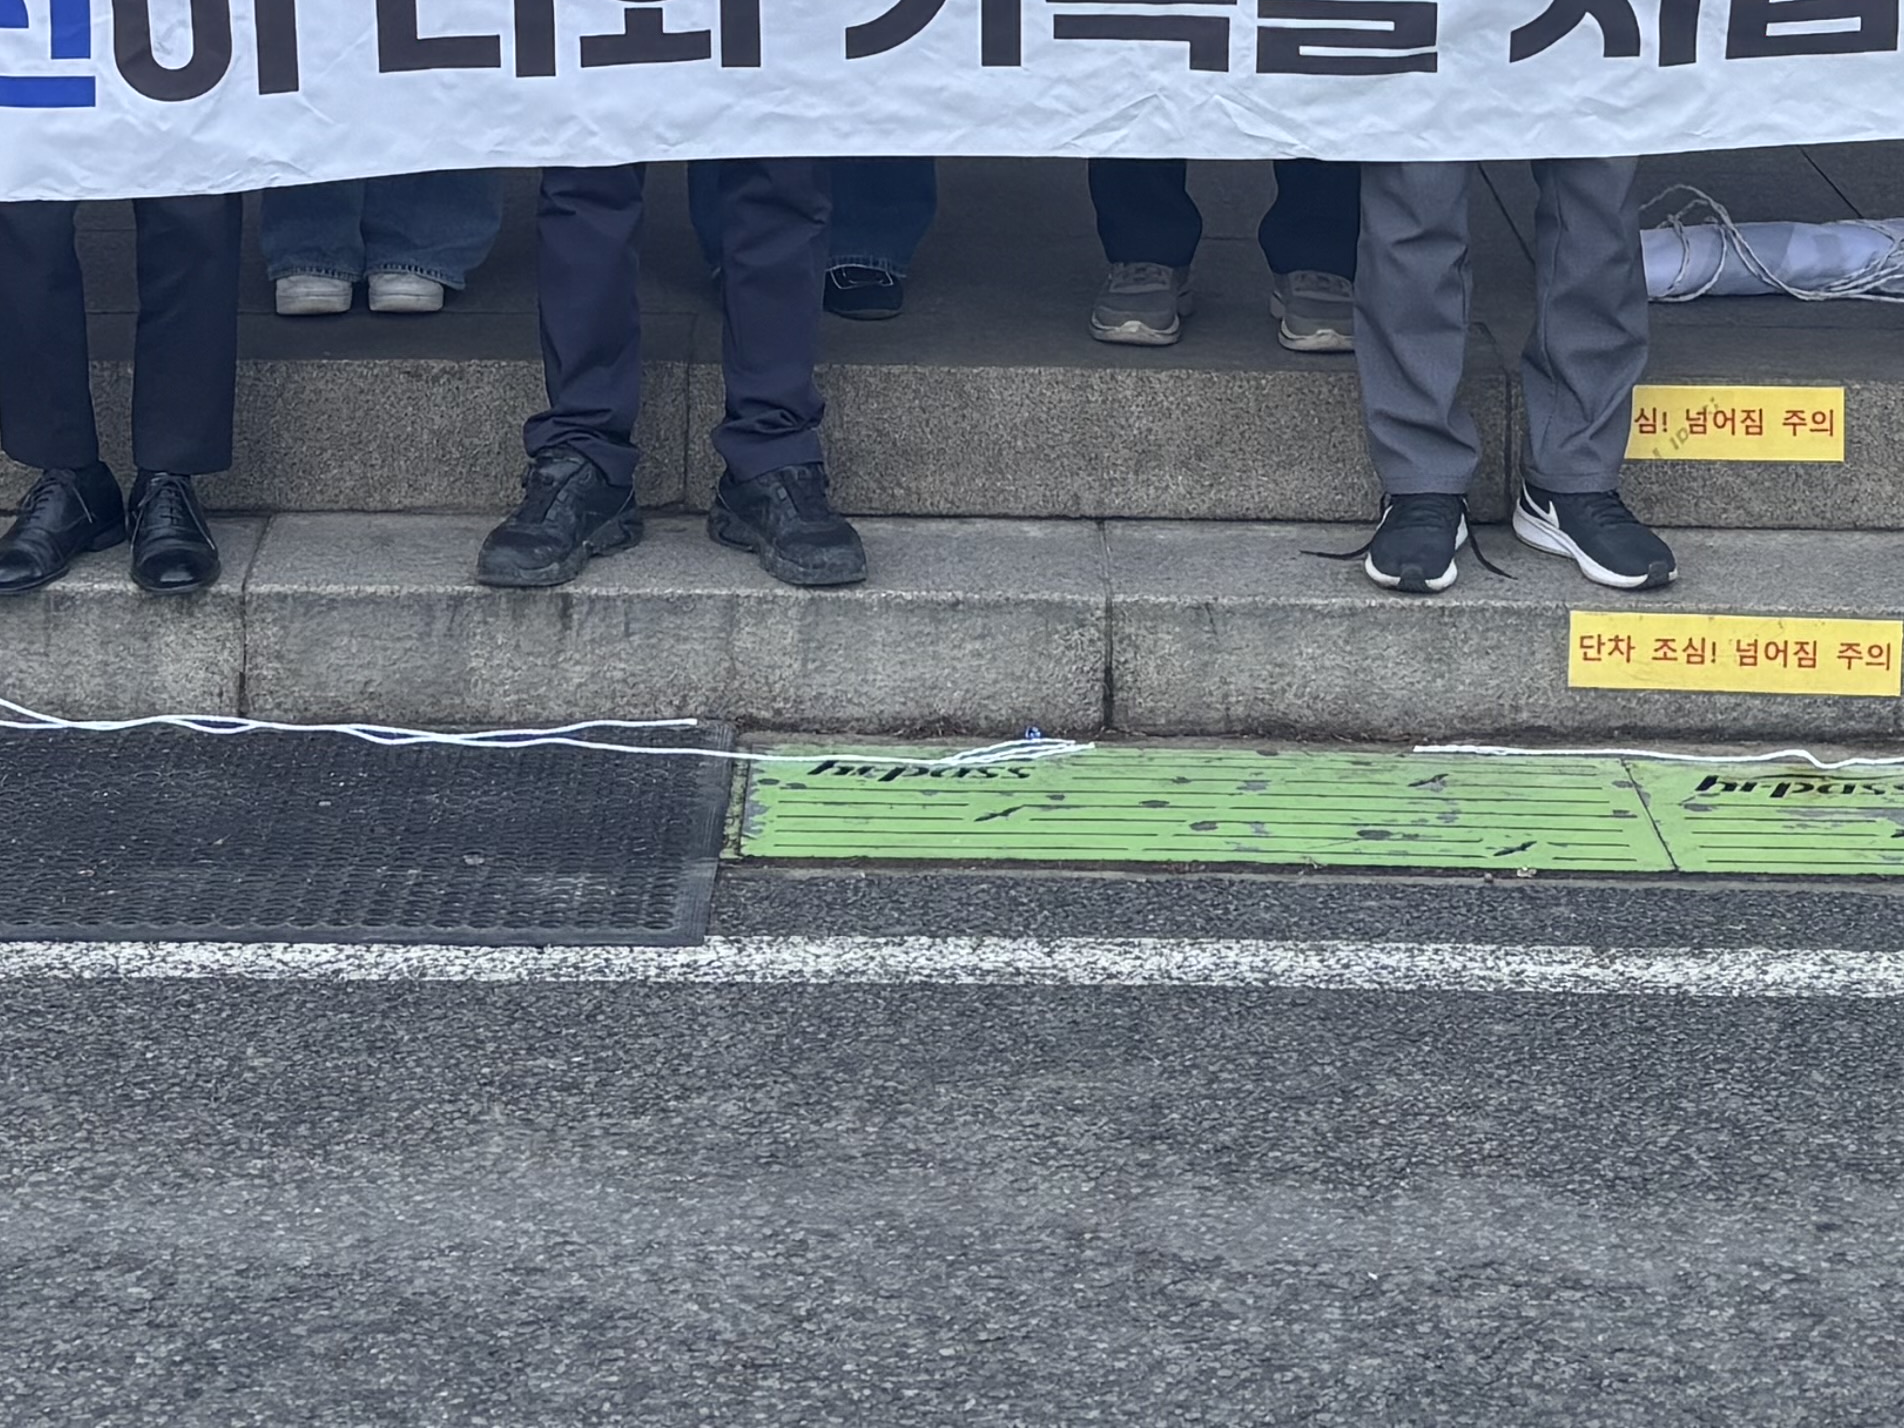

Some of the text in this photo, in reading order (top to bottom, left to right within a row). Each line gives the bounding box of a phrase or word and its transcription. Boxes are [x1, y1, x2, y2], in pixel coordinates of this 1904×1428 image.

[1634, 407, 1669, 435] 심!
[1685, 408, 1764, 438] 넘어짐
[1781, 409, 1835, 438] 주의
[1578, 633, 1892, 671] 단차 조심! 넘어짐 주의
